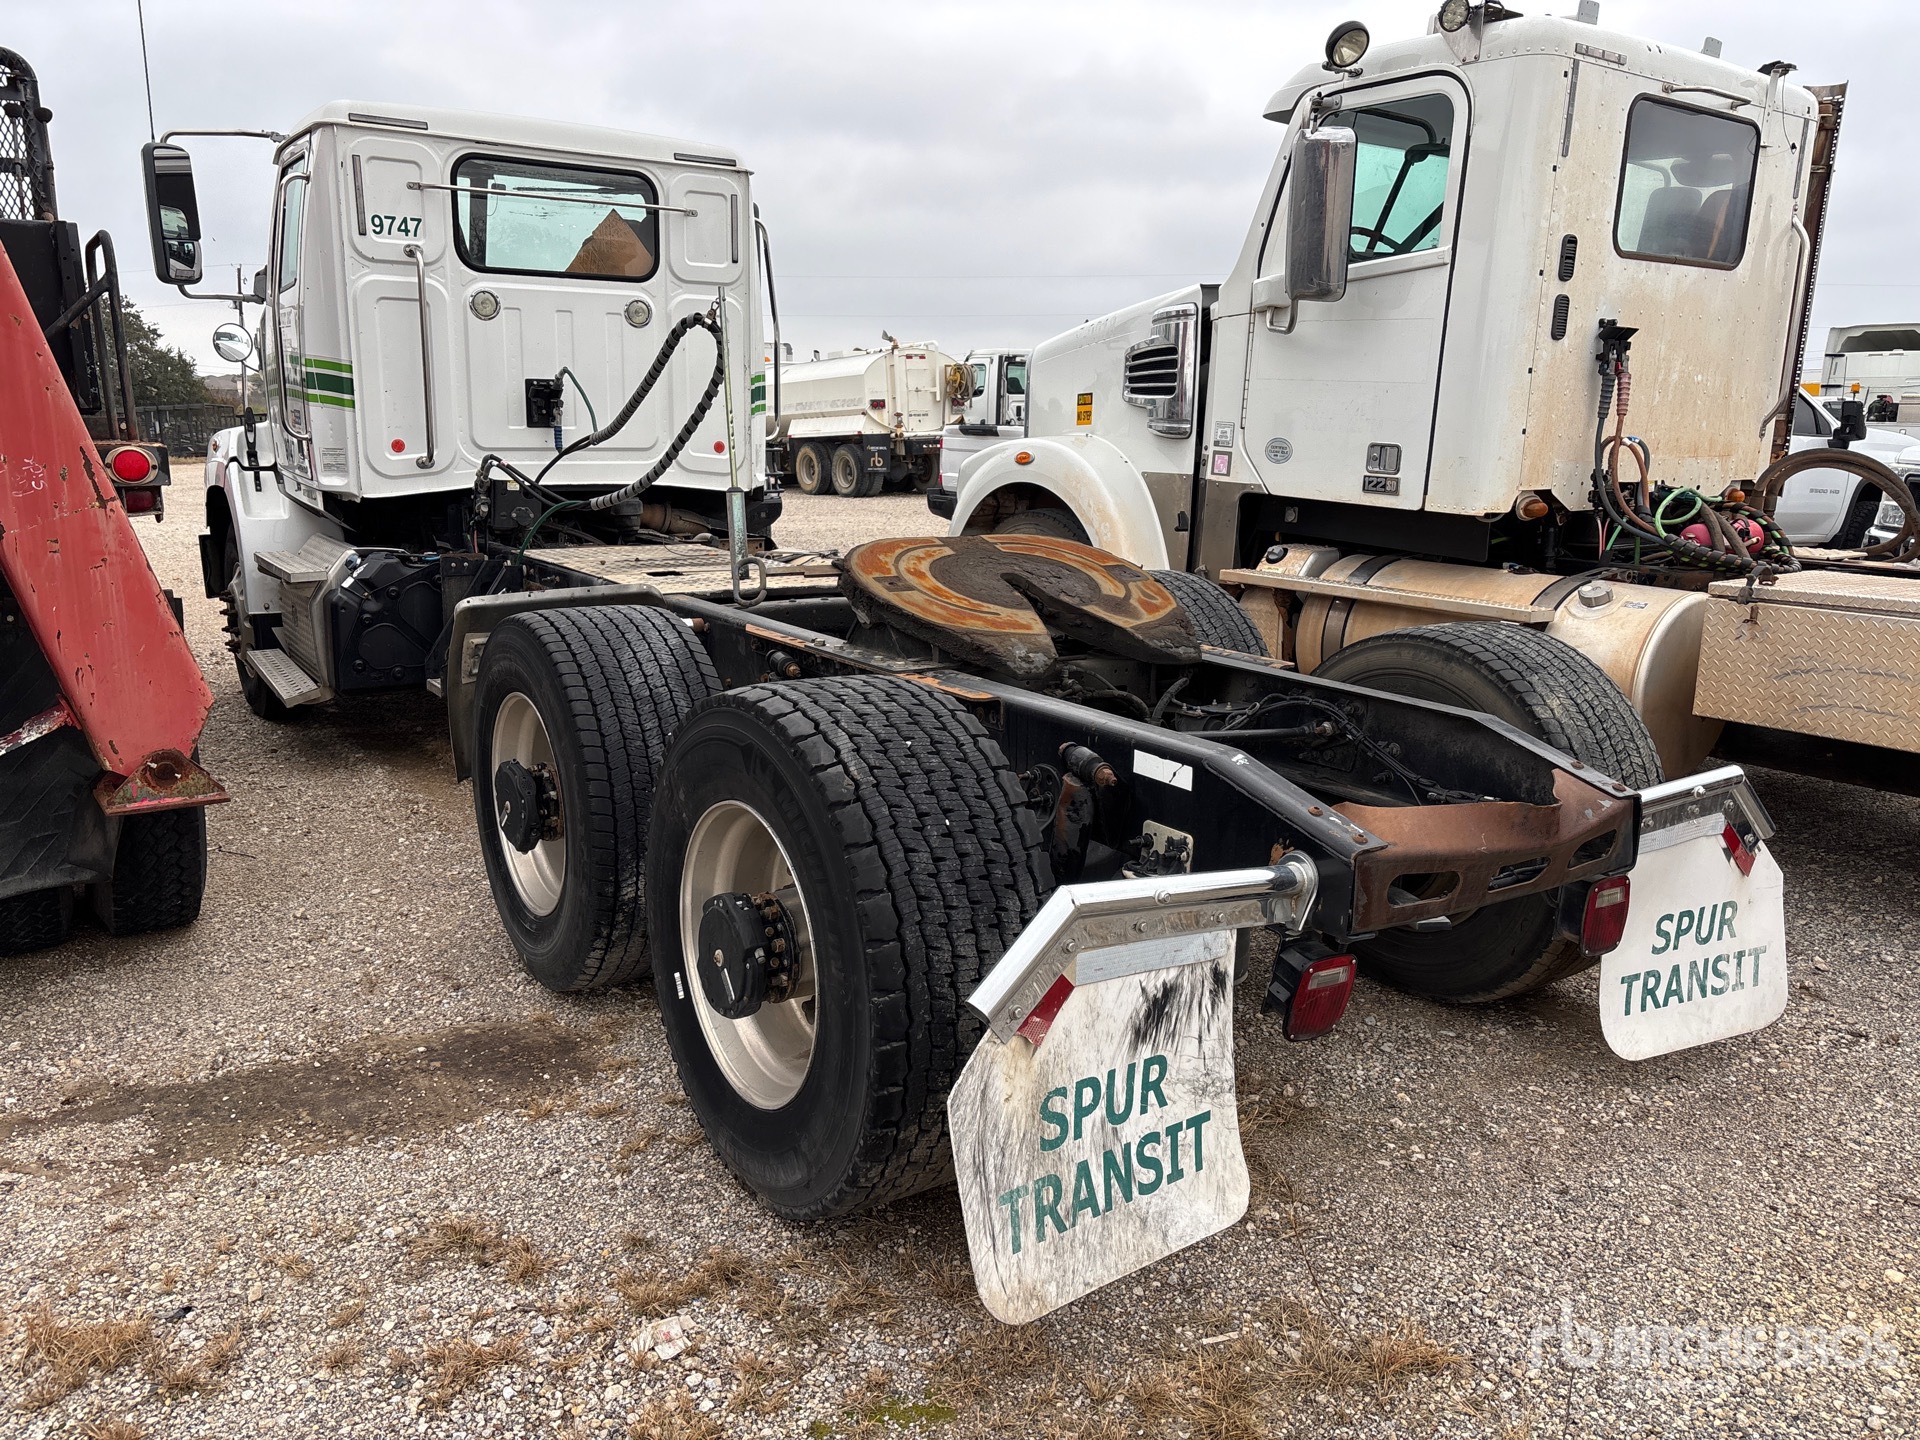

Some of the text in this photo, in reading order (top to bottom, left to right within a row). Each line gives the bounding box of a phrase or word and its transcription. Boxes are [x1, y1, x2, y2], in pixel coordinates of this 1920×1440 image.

[371, 214, 422, 237] 9747
[1651, 900, 1738, 955] SPUR
[1620, 945, 1767, 1016] TRANSIT
[1039, 1054, 1168, 1152] SPUR
[999, 1110, 1211, 1255] TRANSIT
